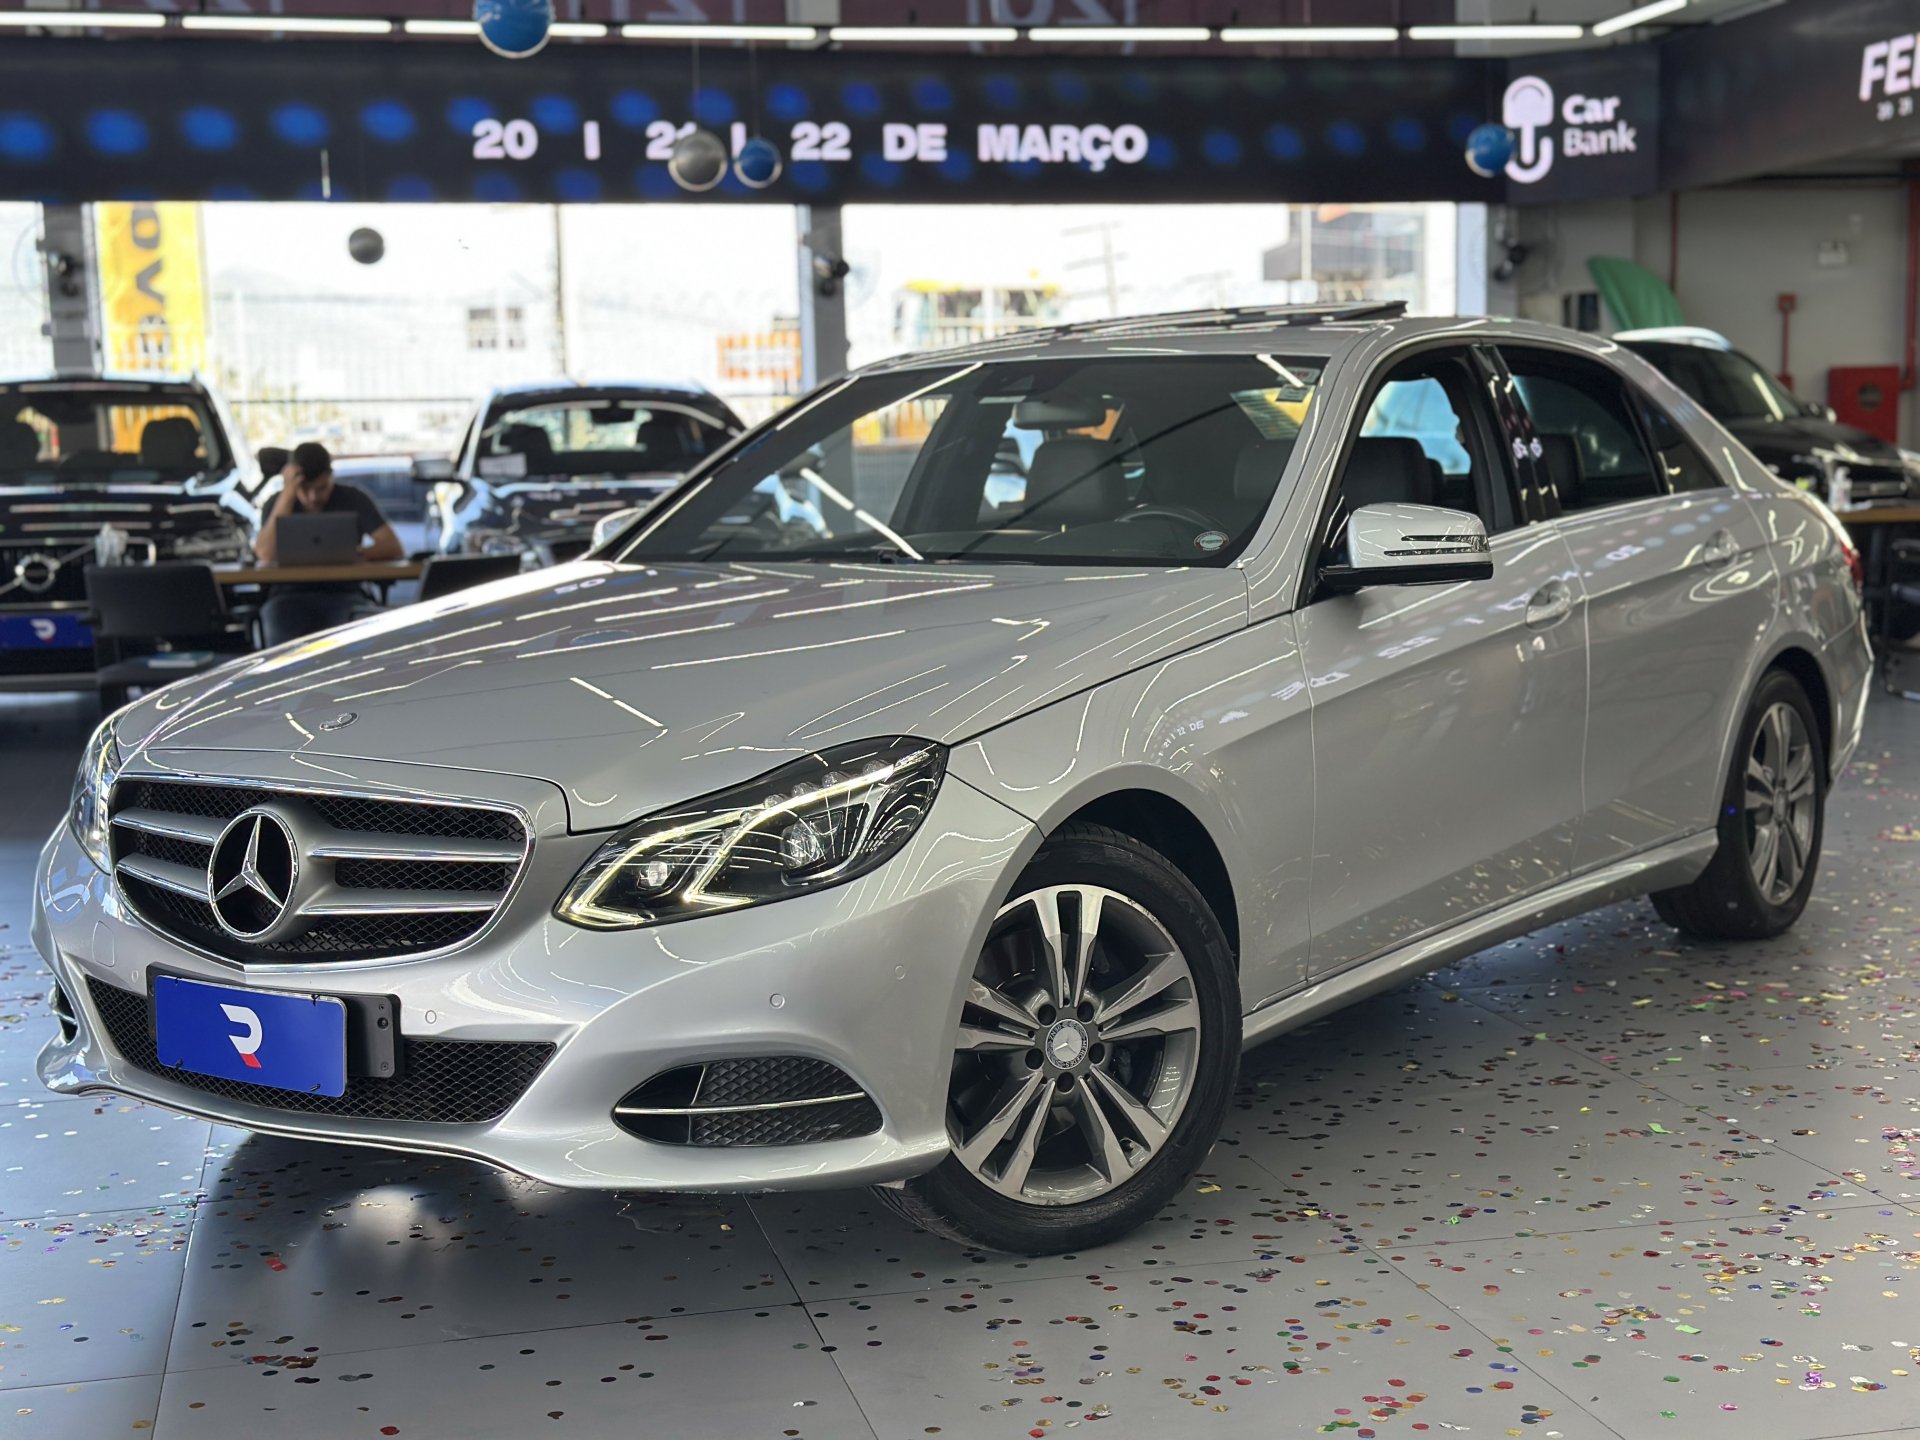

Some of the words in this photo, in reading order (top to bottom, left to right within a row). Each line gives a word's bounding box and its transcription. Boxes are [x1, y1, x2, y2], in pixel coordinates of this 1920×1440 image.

[1562, 93, 1620, 125] Car
[472, 118, 539, 160] 20
[790, 121, 852, 161] 22
[883, 122, 948, 162] DE
[977, 123, 1149, 172] MARÇO
[1563, 119, 1637, 157] Bank
